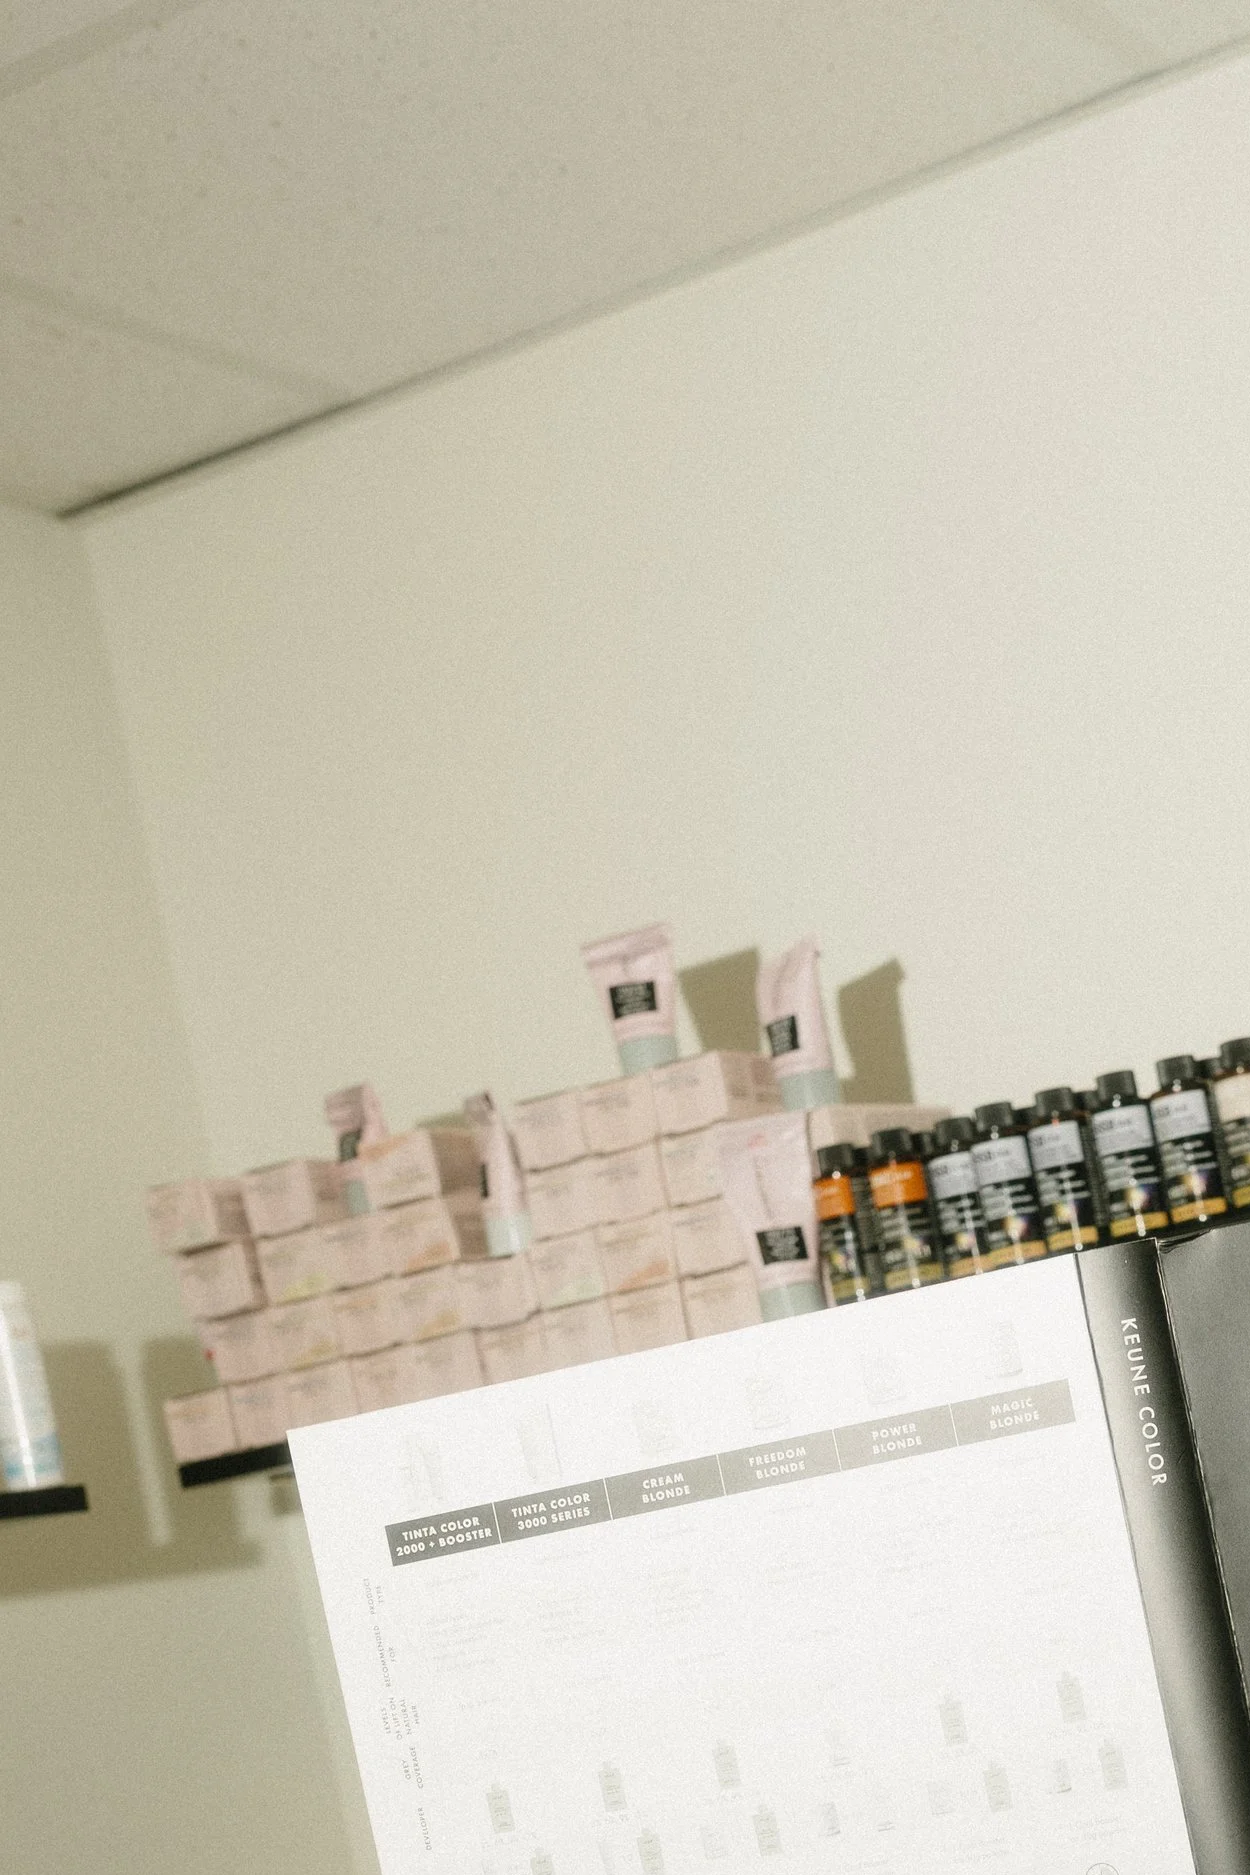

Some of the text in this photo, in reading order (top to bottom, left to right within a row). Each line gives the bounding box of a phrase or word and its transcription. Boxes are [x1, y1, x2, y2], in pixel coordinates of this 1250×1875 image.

[990, 1398, 1033, 1415] MAGIC
[1121, 1317, 1167, 1486] KEUNE COLOR
[989, 1411, 1040, 1430] BLONDE
[871, 1423, 917, 1441] POWER
[872, 1436, 922, 1455] BLONDE
[749, 1447, 806, 1467] FREEDOM
[755, 1461, 806, 1480] BLONDE
[642, 1473, 684, 1490] CREAM
[642, 1486, 690, 1504] BLONDE
[512, 1493, 590, 1518] TINTA COLOR
[517, 1507, 590, 1530] 3000 SERIES
[402, 1517, 480, 1541] TINTA COLOR
[396, 1542, 425, 1556] 2000
[439, 1528, 492, 1547] BOOSTER
